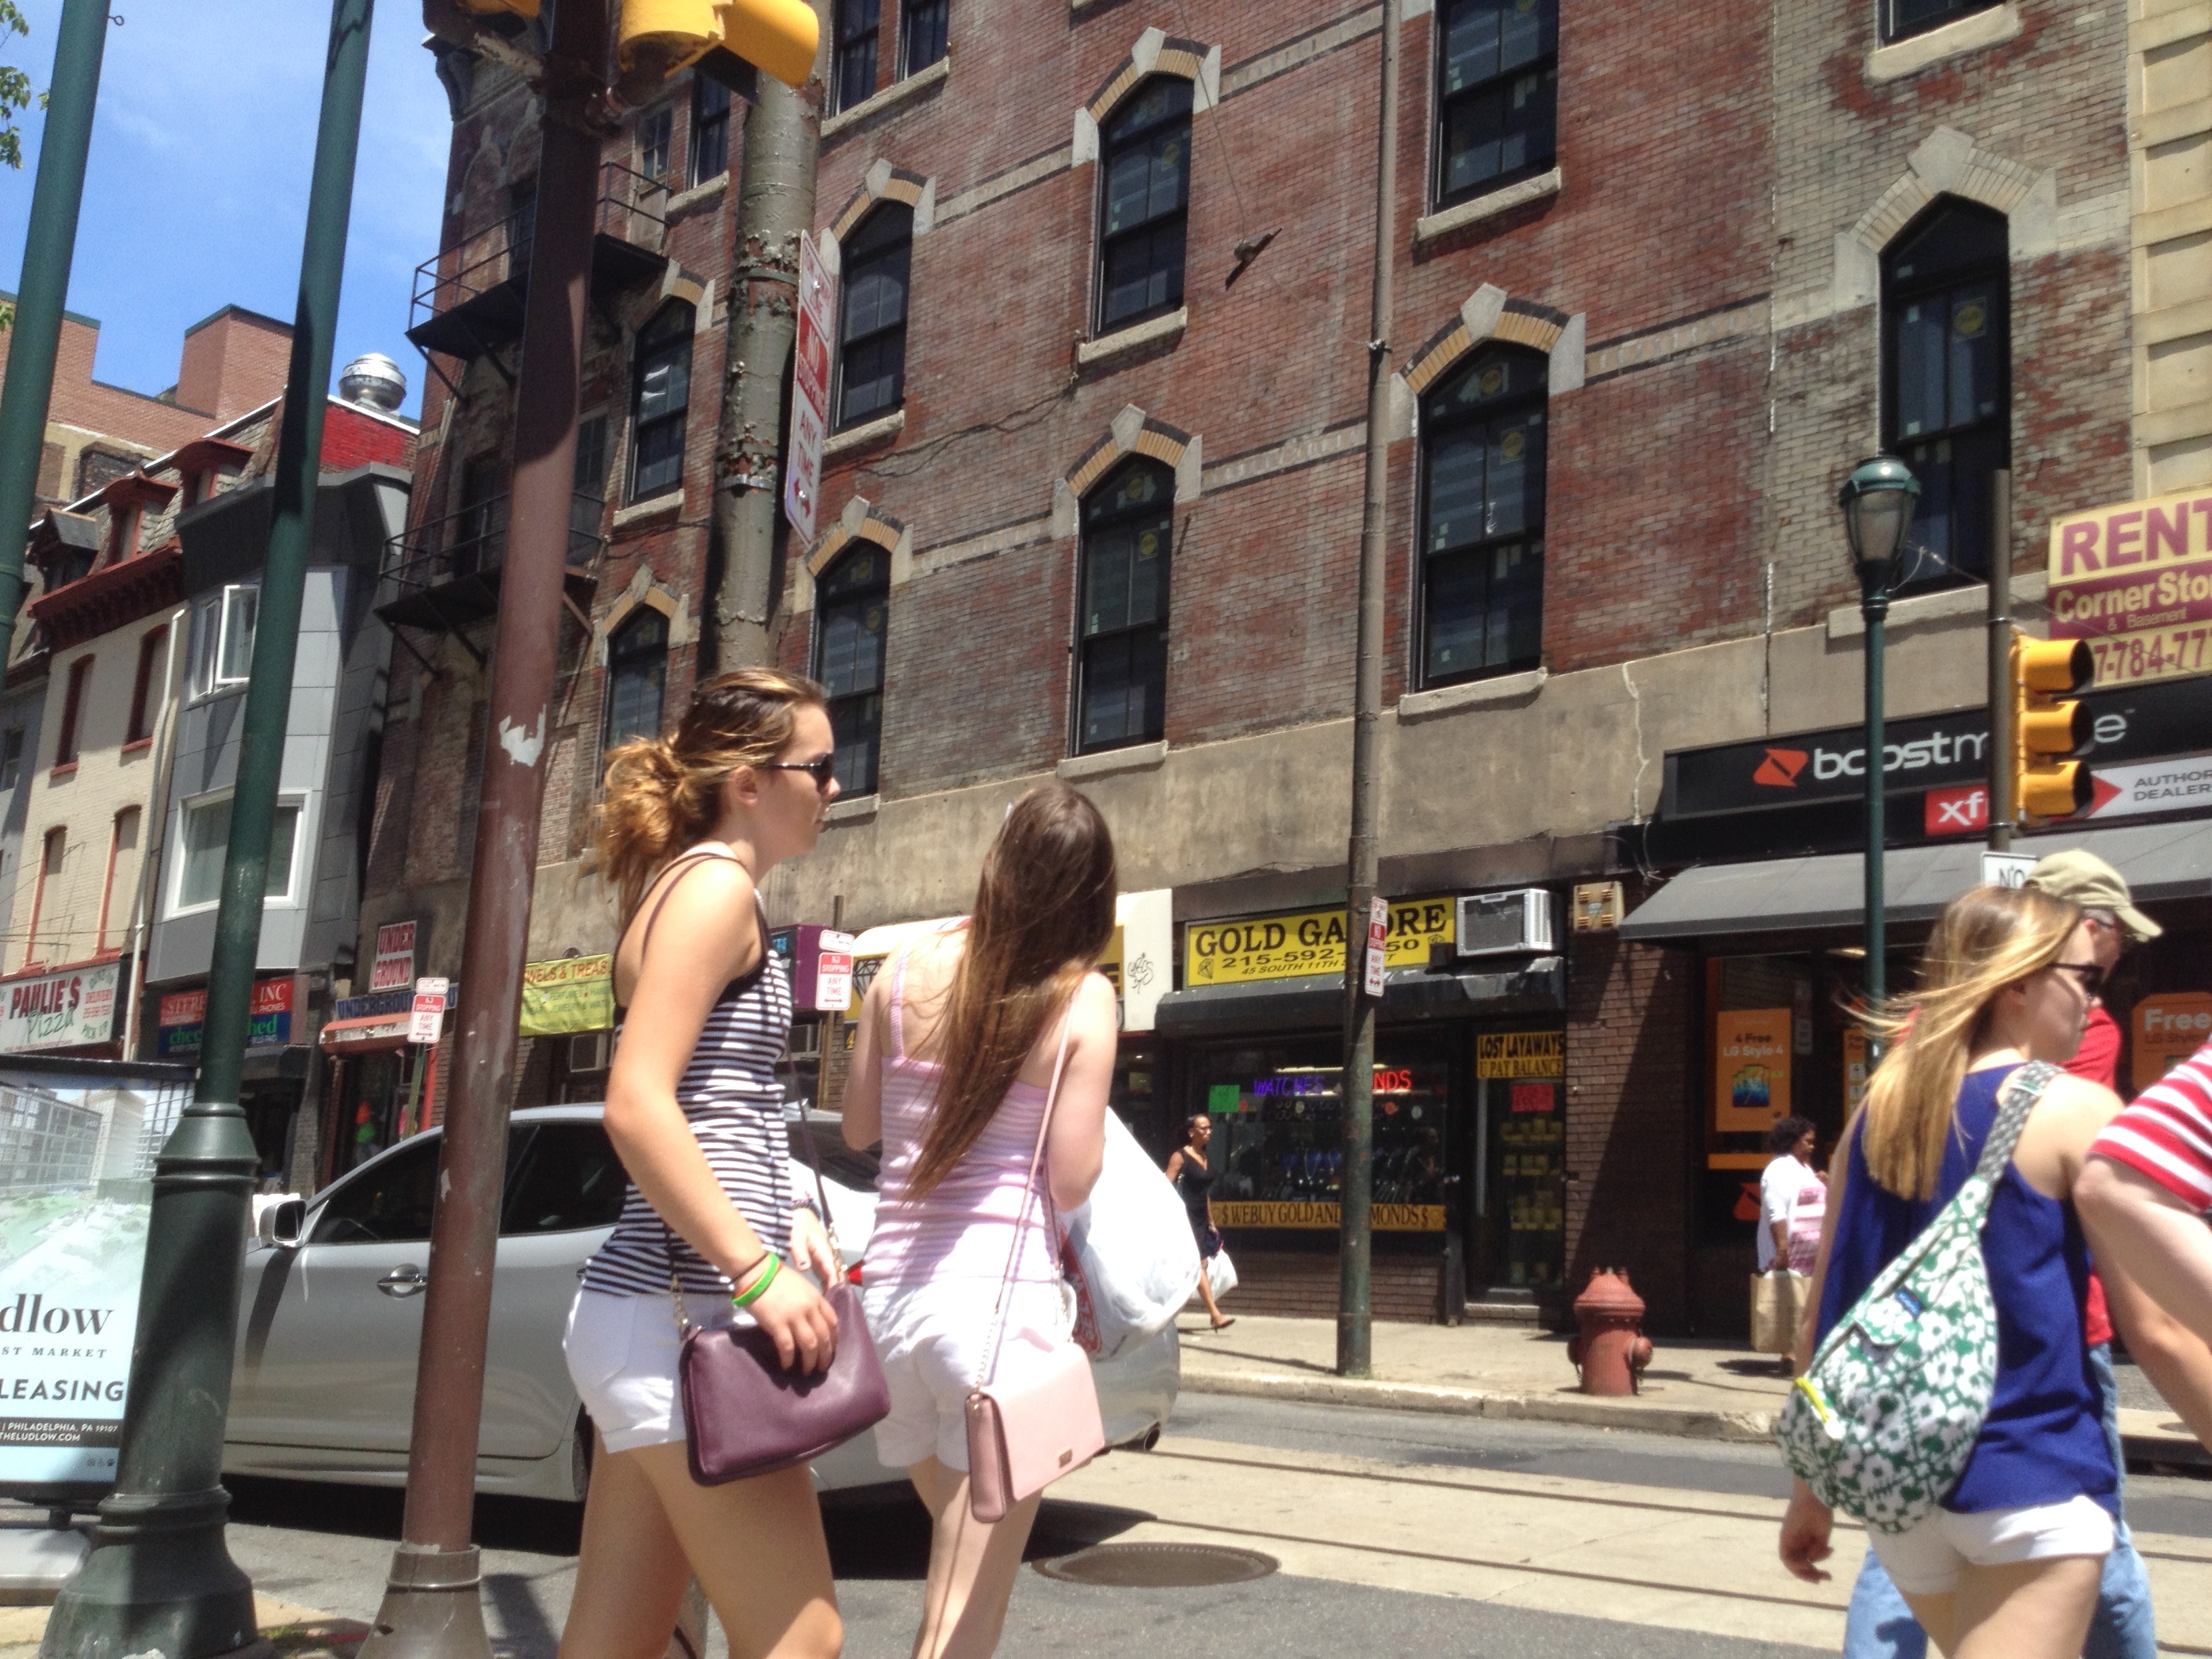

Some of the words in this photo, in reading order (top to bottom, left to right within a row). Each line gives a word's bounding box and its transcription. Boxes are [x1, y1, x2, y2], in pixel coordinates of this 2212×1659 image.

[2061, 498, 2212, 577] RENT
[2054, 581, 2155, 623] Corner
[2157, 570, 2212, 606] Sto
[2107, 617, 2118, 632] &
[2125, 607, 2188, 629] Basement
[2094, 626, 2212, 682] 7-784-77
[2133, 783, 2211, 801] DEALER
[1999, 867, 2026, 888] NO
[378, 923, 415, 956] UNDER
[1195, 922, 1286, 958] GOLD
[1298, 904, 1447, 947] GARE
[1222, 939, 1420, 969] 215-592-50
[373, 956, 412, 987] GROUND
[571, 960, 612, 979] TREAS
[1241, 966, 1256, 976] 45
[1258, 962, 1303, 975] SOUTH
[1307, 959, 1338, 970] 11TH
[827, 977, 842, 985] ANY
[827, 987, 842, 996] TIME
[260, 983, 287, 1003] INC
[2144, 1008, 2212, 1031] Free
[1479, 1036, 1504, 1059] LOST
[1506, 1033, 1565, 1058] LAYAWAYS
[1490, 1060, 1511, 1077] PAY
[1253, 1076, 1326, 1097] WATCHES
[32, 1347, 107, 1358] MARKET
[0, 1378, 125, 1402] LEASING
[7, 1422, 79, 1432] PHILADELPHIA,
[81, 1423, 94, 1431] PA
[96, 1425, 119, 1433] 19107
